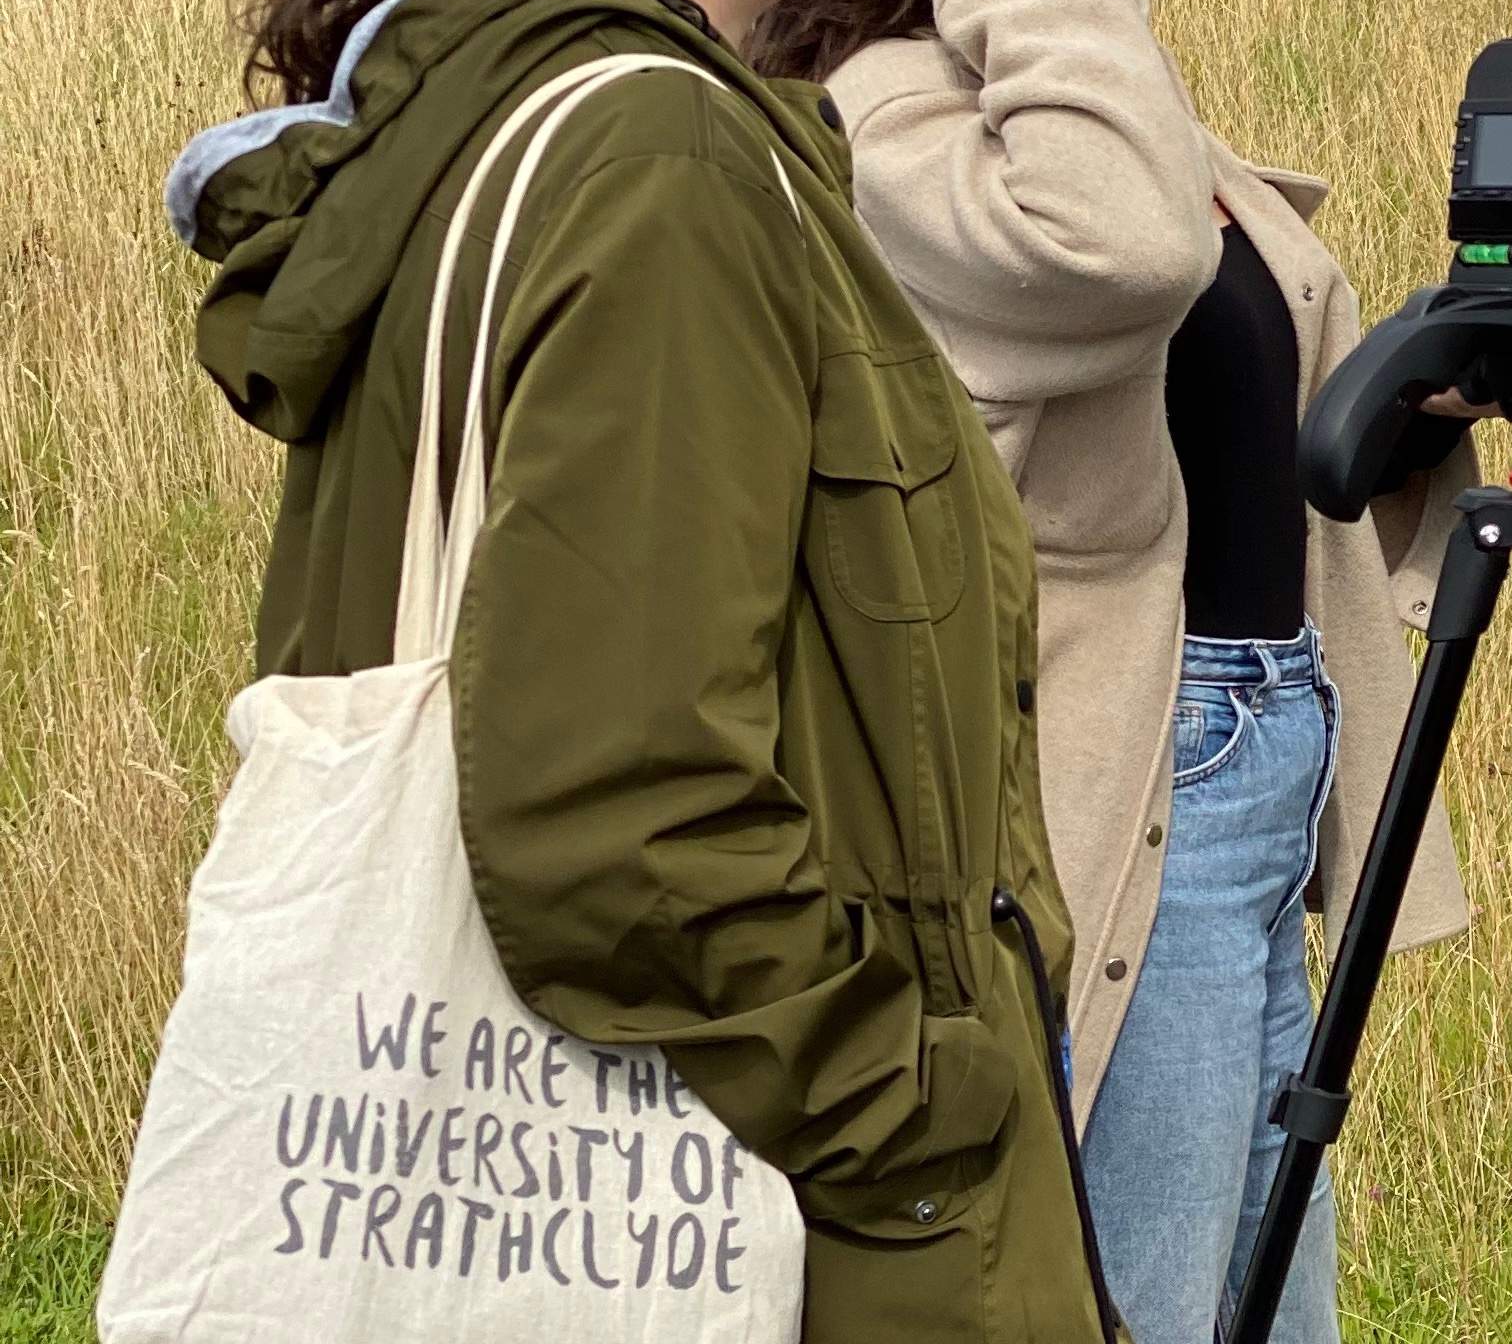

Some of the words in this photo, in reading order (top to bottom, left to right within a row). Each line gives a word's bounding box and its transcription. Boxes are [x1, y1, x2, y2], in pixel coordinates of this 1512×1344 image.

[355, 991, 448, 1078] WE
[464, 1016, 570, 1108] ARE
[589, 1049, 692, 1119] THE
[670, 1130, 745, 1211] OF
[274, 1177, 748, 1294] STRATHCLYDE
